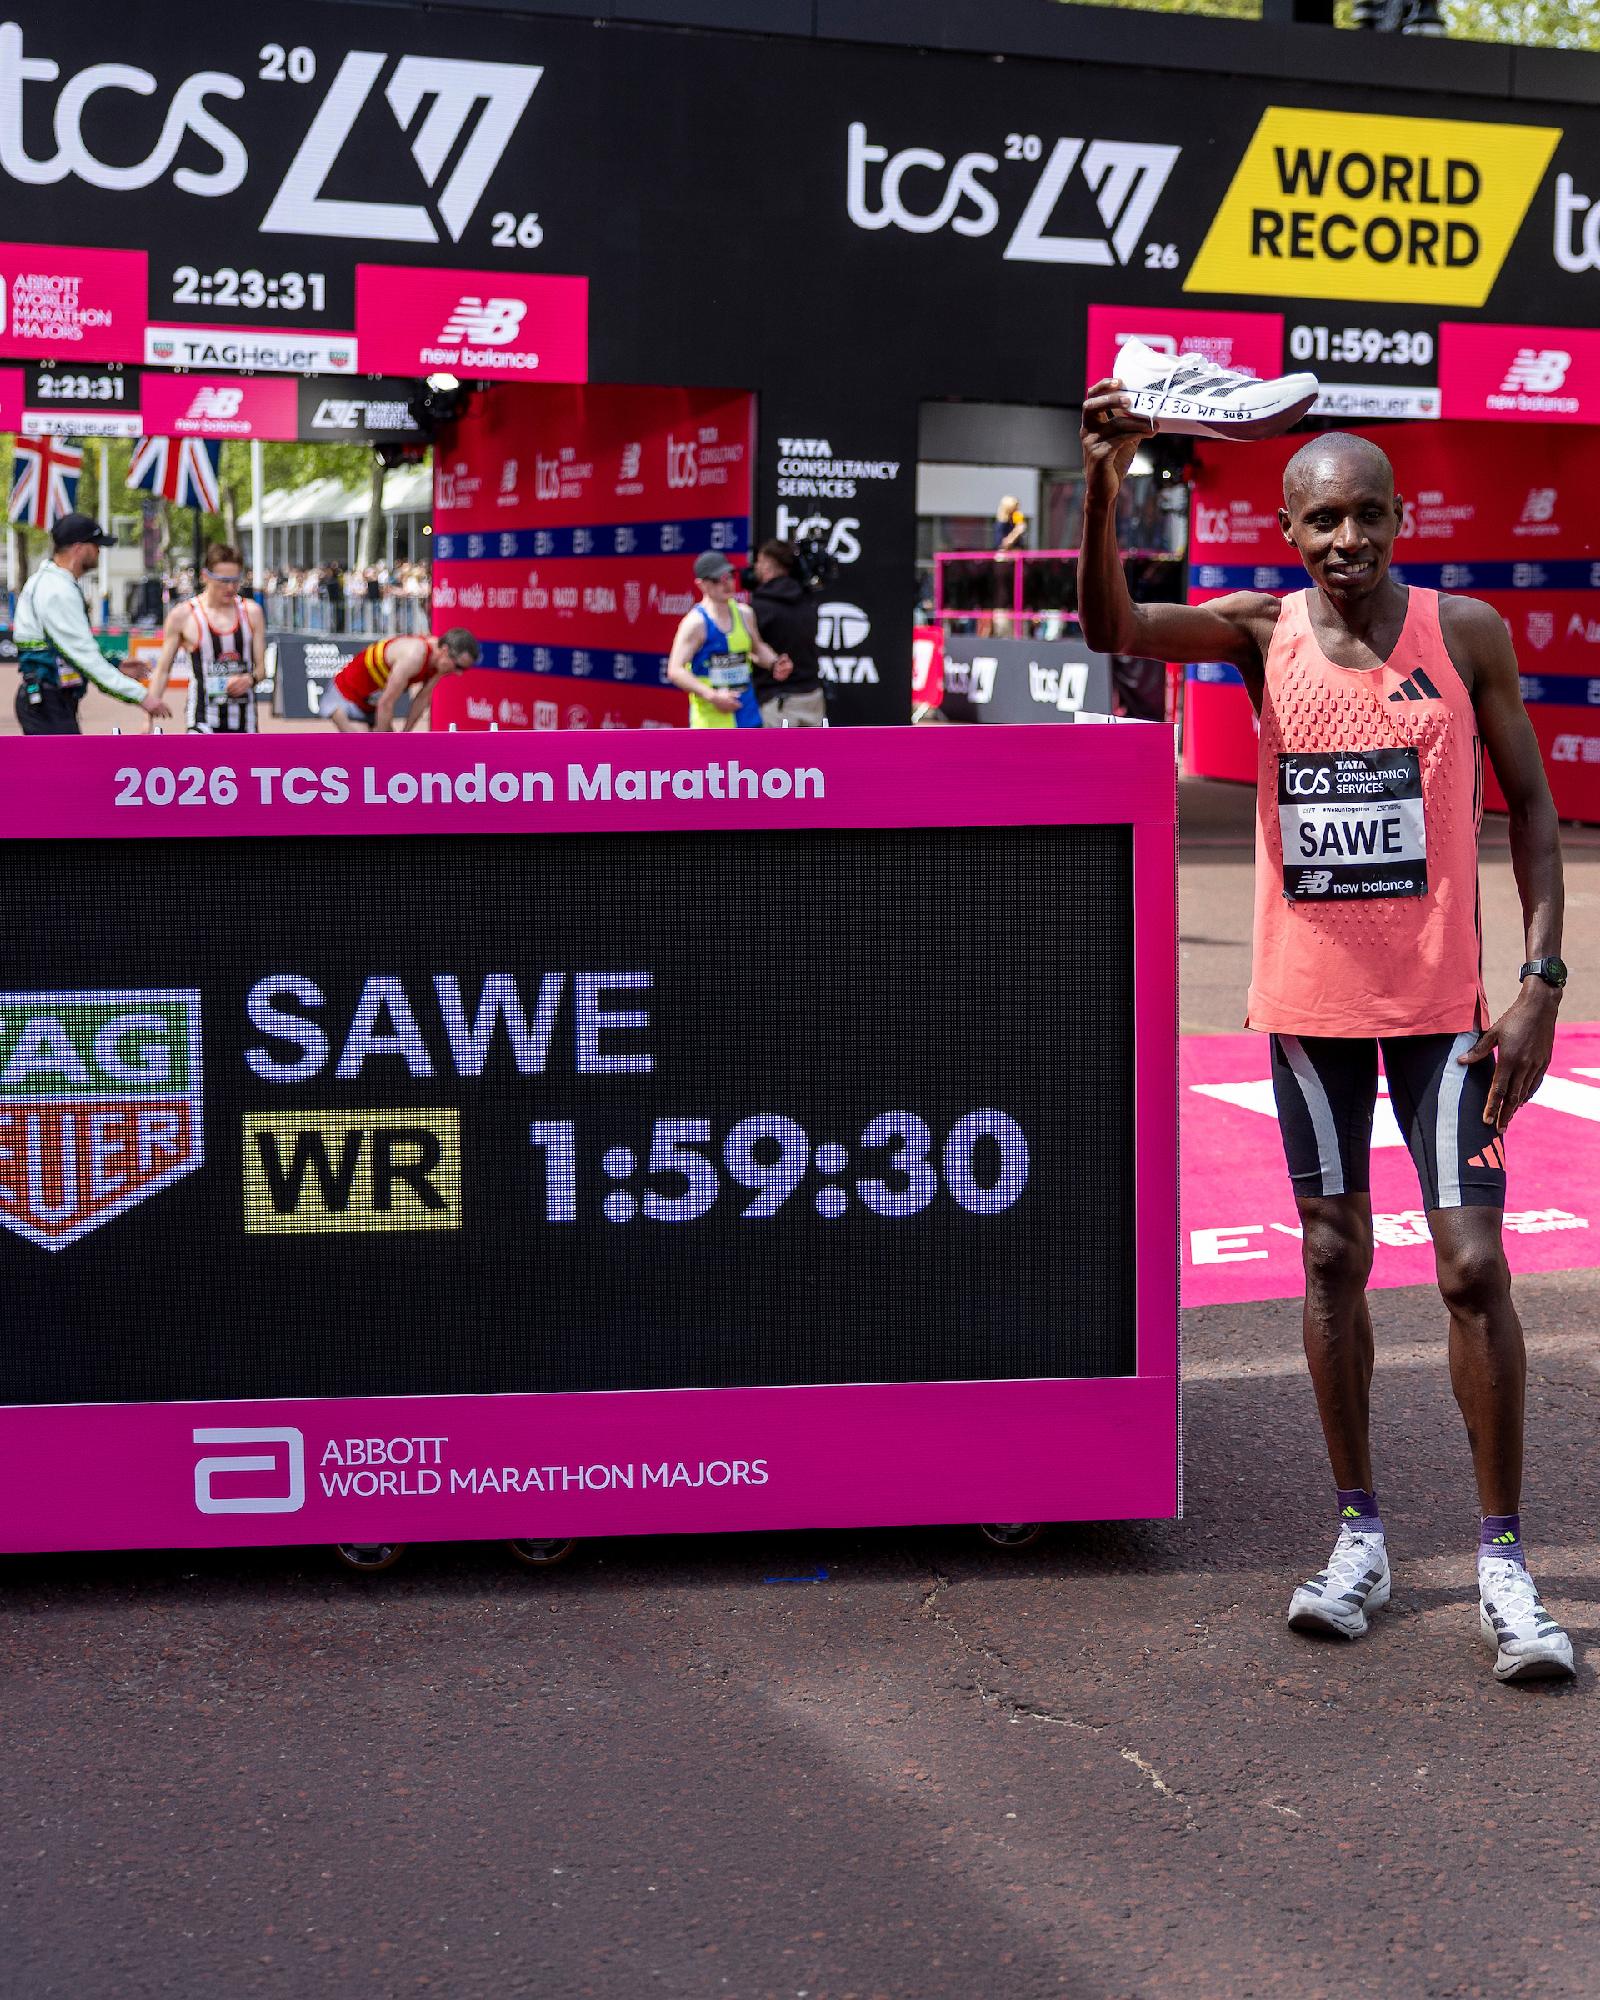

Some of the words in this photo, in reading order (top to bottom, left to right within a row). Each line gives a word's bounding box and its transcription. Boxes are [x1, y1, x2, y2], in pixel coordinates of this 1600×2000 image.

[259, 43, 316, 83] 20
[0, 21, 248, 197] tcs
[1004, 133, 1043, 161] 20
[847, 121, 999, 237] tcs
[1274, 146, 1480, 206] WORLD
[491, 213, 544, 248] 26
[1250, 208, 1480, 268] RECORD
[1145, 243, 1180, 269] 26
[13, 273, 83, 294] ABBOTT
[172, 265, 326, 311] 2:23:31
[13, 291, 79, 310] WORLD
[13, 306, 112, 327] MARATHON
[13, 322, 83, 340] MAJORS
[1290, 325, 1433, 366] 01:59:30
[419, 347, 459, 364] new
[461, 348, 539, 369] balance
[37, 374, 124, 400] 2:23:31
[667, 432, 698, 489] tcs
[777, 438, 833, 458] TATA
[777, 458, 900, 480] CONSULTANCY
[777, 477, 857, 499] SERVICES
[1196, 502, 1229, 544] tcs
[817, 656, 880, 683] ATA
[1286, 763, 1331, 795] tcs
[1335, 761, 1367, 770] TATA
[1335, 768, 1410, 783] CONSULTANCY
[114, 766, 238, 807] 2026
[250, 765, 350, 806] TCS
[364, 763, 553, 805] London
[567, 761, 826, 802] Marathon
[1336, 782, 1384, 794] SERVICES
[1299, 818, 1402, 858] SAWE
[1333, 882, 1358, 894] new
[1361, 879, 1414, 893] balance
[243, 971, 655, 1084] SAWE
[255, 1129, 450, 1214] WR
[529, 1107, 1030, 1223] 1:59:30
[320, 1436, 448, 1468] ABBOTT
[320, 1470, 441, 1498] WORLD
[450, 1463, 634, 1495] MARATHON
[641, 1459, 769, 1489] MAJORS
